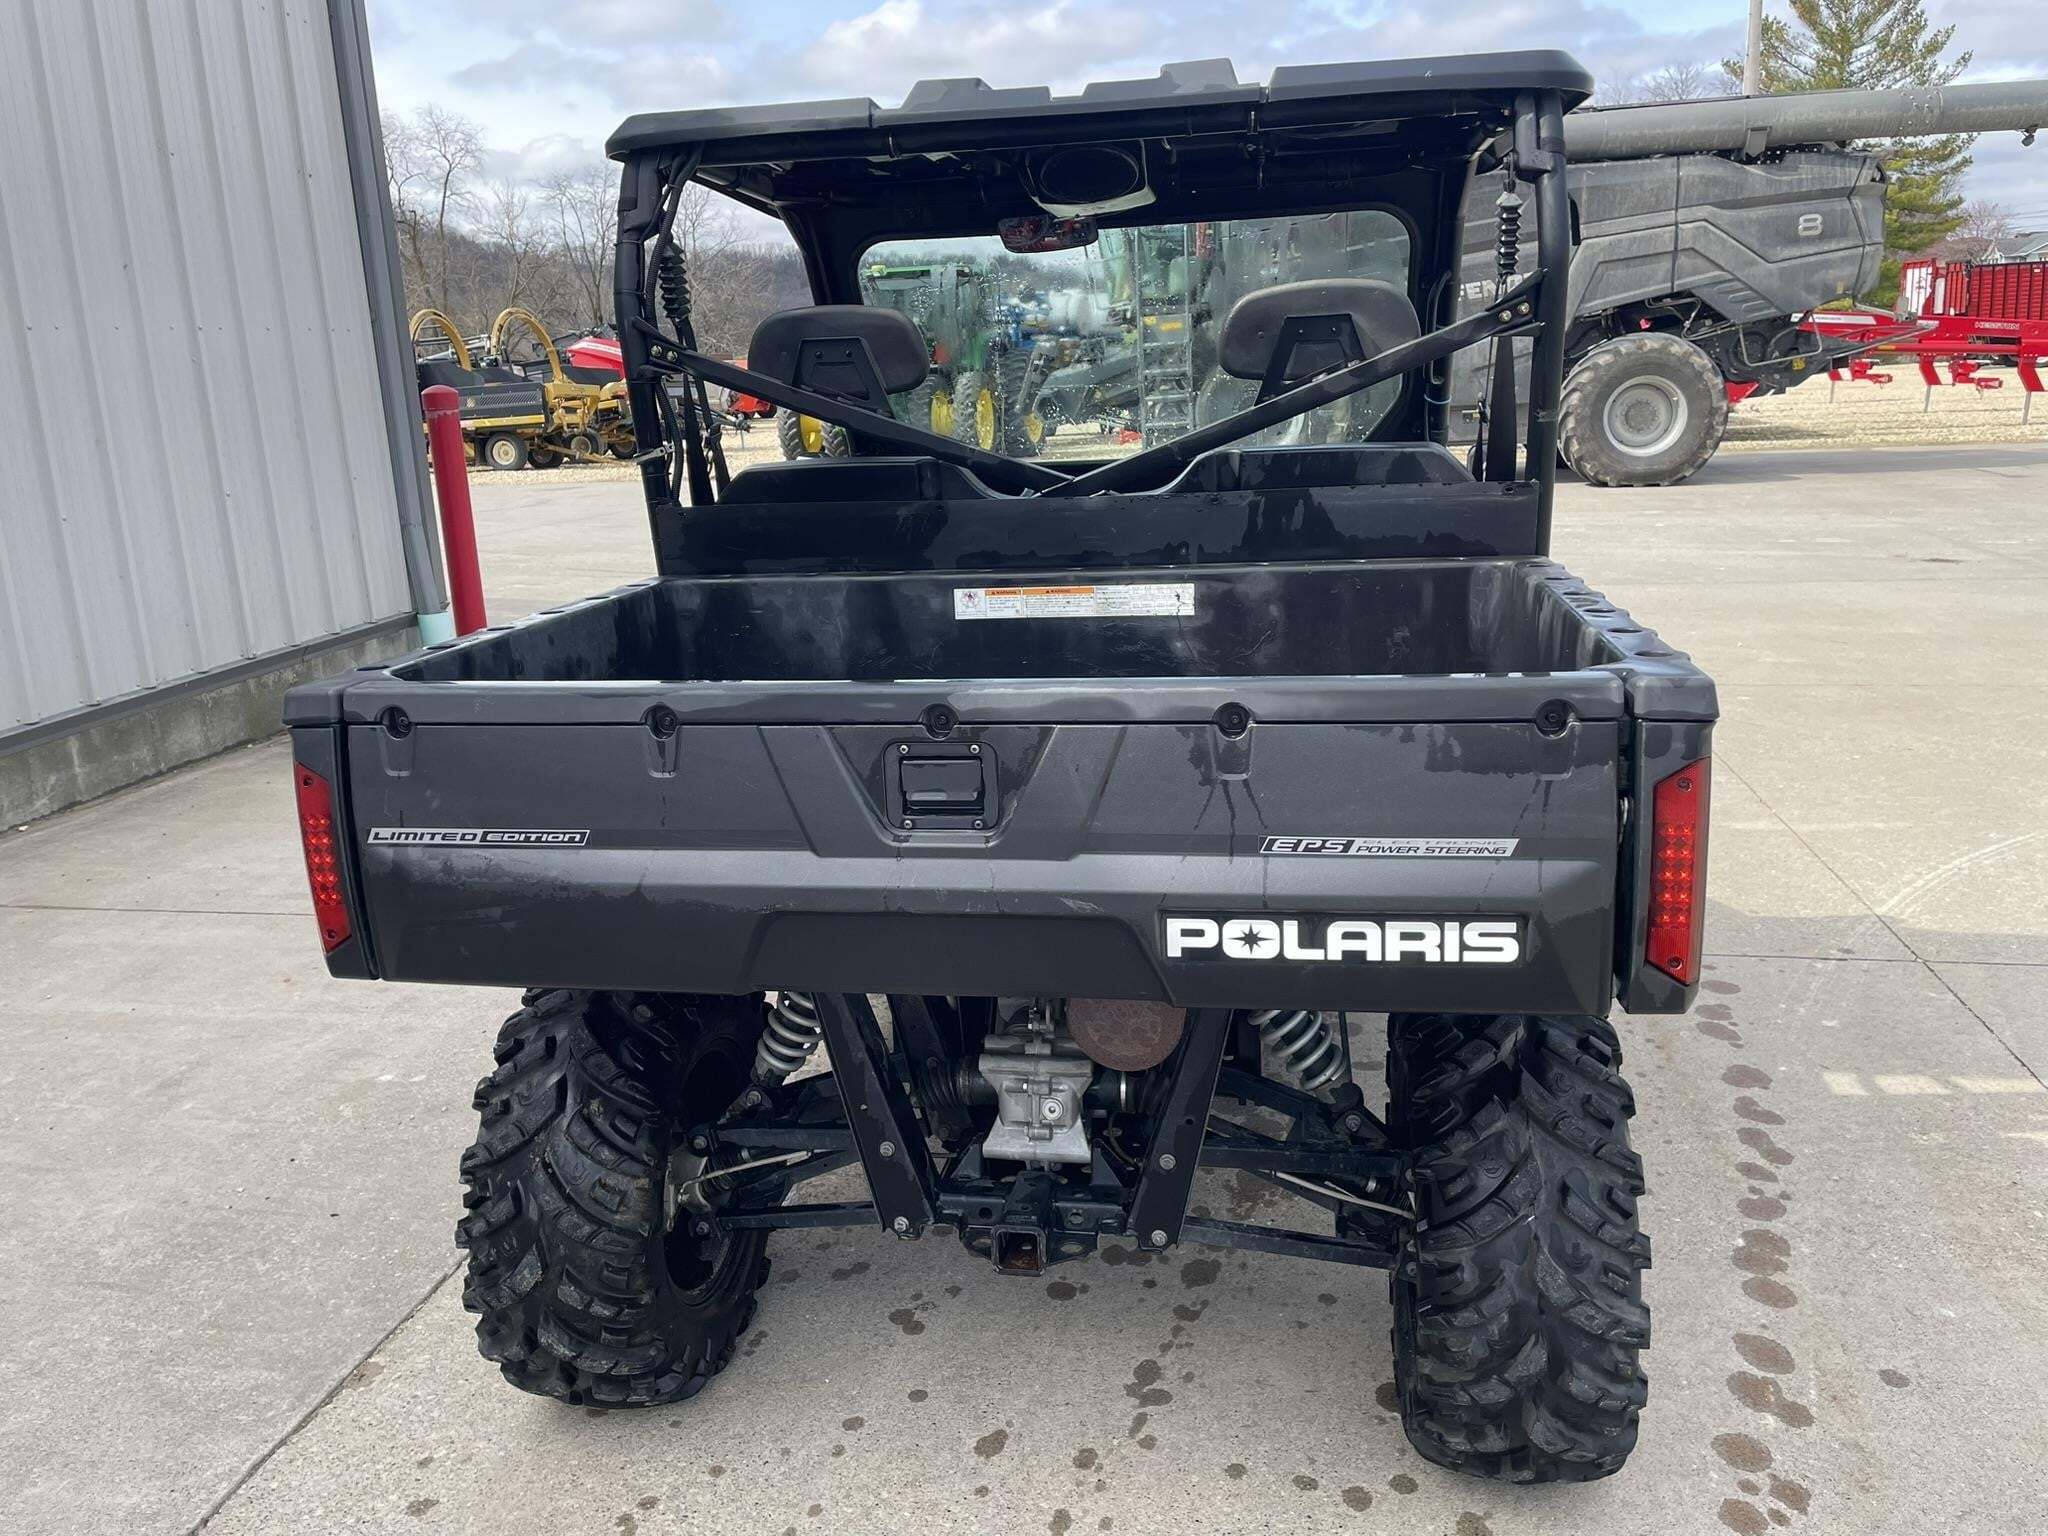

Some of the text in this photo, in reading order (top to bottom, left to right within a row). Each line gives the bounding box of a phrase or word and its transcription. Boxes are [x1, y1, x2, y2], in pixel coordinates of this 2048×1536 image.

[1798, 213, 1823, 236] 8
[372, 831, 581, 843] LIMITED EDITION
[1271, 839, 1348, 853] EPS
[1355, 845, 1510, 855] POWER STEERING
[1166, 918, 1520, 963] POLARIS
